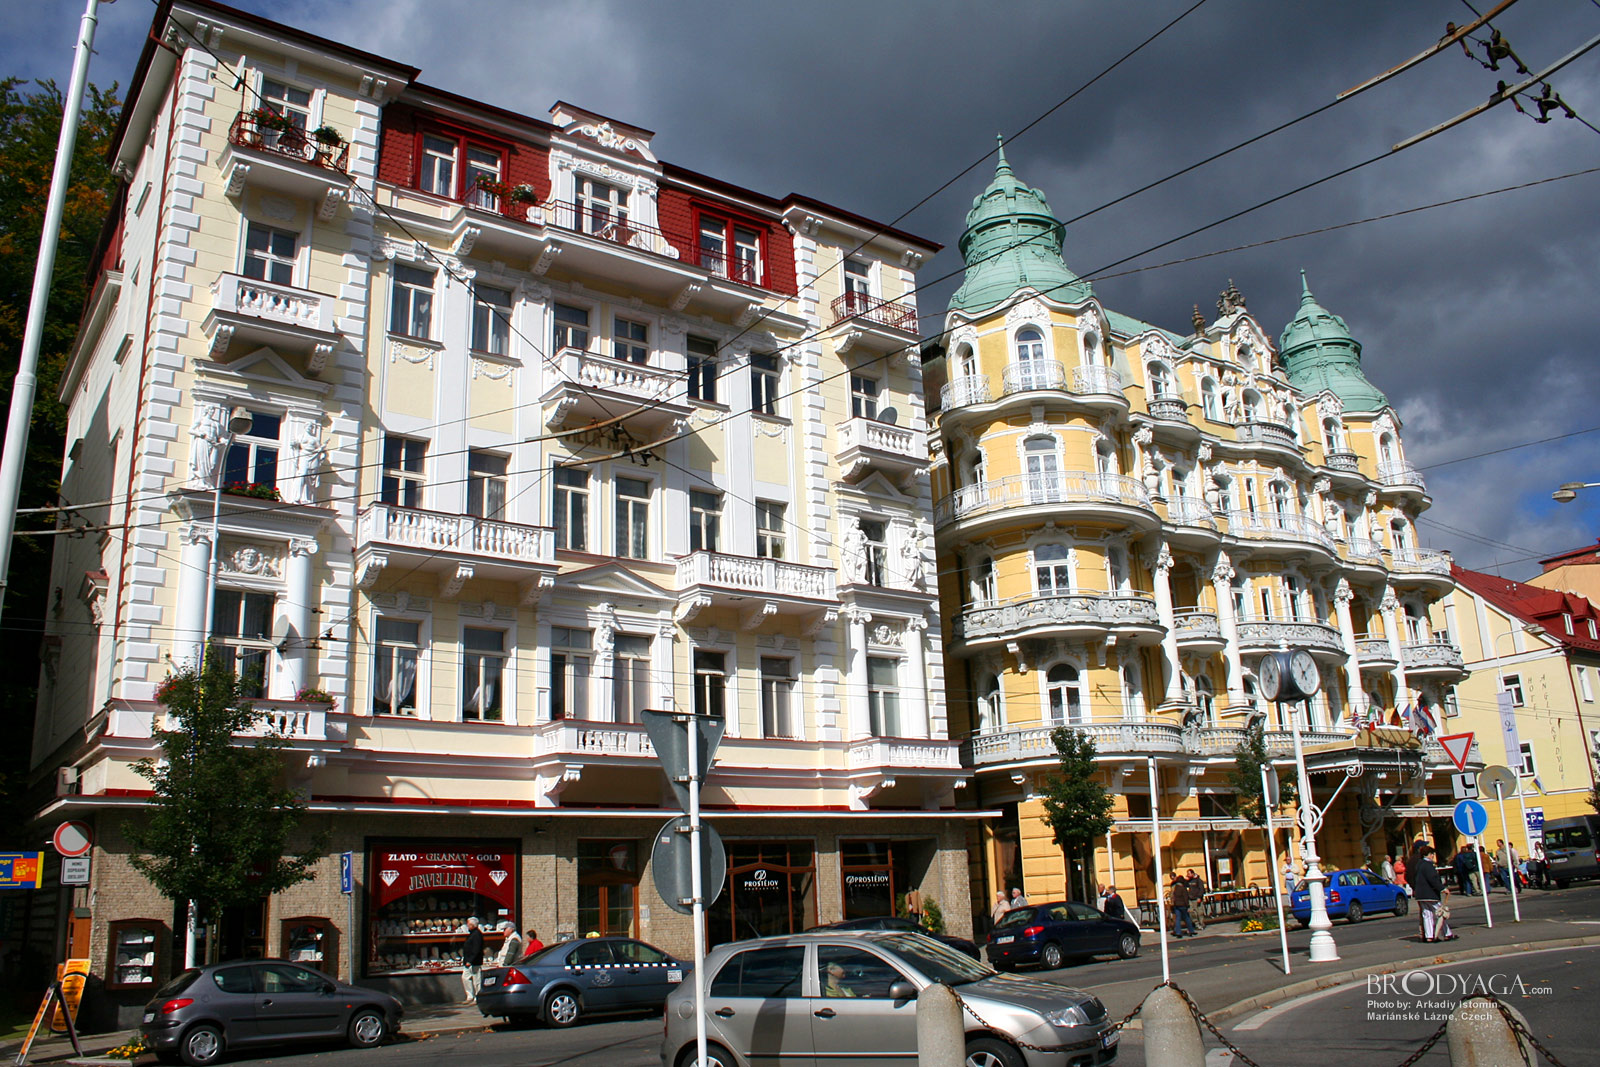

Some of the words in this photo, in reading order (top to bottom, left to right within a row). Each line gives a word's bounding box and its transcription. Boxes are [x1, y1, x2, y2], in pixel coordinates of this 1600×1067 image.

[388, 853, 417, 861] ZLATO
[425, 853, 469, 861] GRANAT
[408, 872, 479, 891] JEWELLERY
